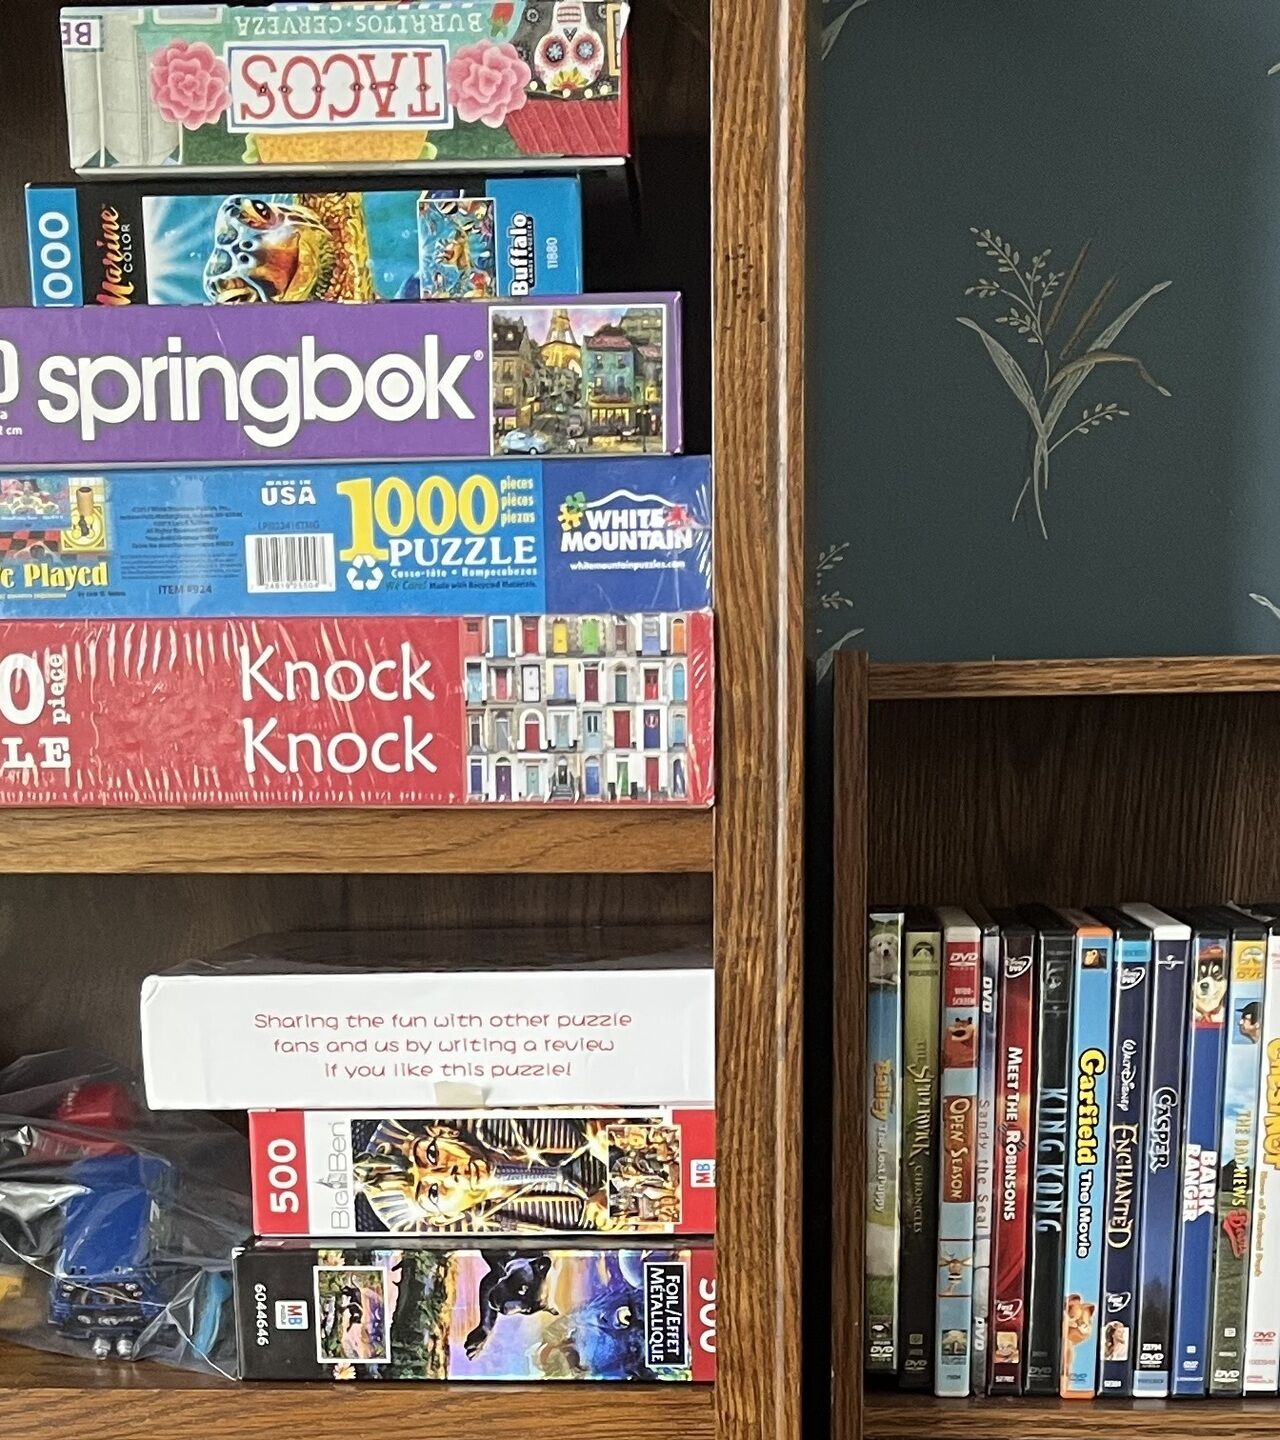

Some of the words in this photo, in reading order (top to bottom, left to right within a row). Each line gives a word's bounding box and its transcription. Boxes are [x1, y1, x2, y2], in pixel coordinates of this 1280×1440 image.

[242, 52, 443, 121] TACOS
[123, 222, 131, 277] COLOR
[509, 211, 529, 296] Buffalo
[37, 334, 473, 447] springbok
[261, 485, 316, 505] USA
[500, 476, 533, 491] pieces
[336, 475, 498, 562] 1000
[500, 511, 535, 526] piezas
[561, 530, 693, 553] MOUNTAIN
[585, 509, 665, 530] WHITE
[24, 561, 108, 587] Played
[389, 537, 536, 566] PUZZLE
[570, 560, 685, 571] whitemountainpuzzles.com
[49, 652, 69, 726] piece
[240, 642, 437, 704] Knock
[242, 714, 438, 776] Knock
[254, 1013, 338, 1030] Sharing
[347, 1014, 384, 1028] the
[392, 1014, 427, 1028] fun
[434, 1014, 482, 1028] with
[490, 1014, 549, 1027] other
[558, 1012, 632, 1030] puzzle
[274, 1038, 318, 1053] fans
[327, 1038, 366, 1052] and
[376, 1040, 398, 1052] us
[406, 1038, 432, 1054] by
[440, 1037, 516, 1054] writing
[524, 1040, 536, 1052] a
[544, 1038, 614, 1052] review
[324, 1062, 336, 1077] if
[345, 1064, 384, 1079] you
[394, 1062, 432, 1077] like
[441, 1062, 484, 1077] this
[492, 1062, 572, 1079] puzzle!
[1007, 1047, 1023, 1088] MEET
[950, 1098, 970, 1141] OPEN
[1006, 1093, 1020, 1121] THE
[1038, 1087, 1069, 1152] KING
[1076, 1048, 1107, 1164] Garfield
[1150, 1086, 1178, 1173] CASPER
[268, 1138, 299, 1214] 500
[950, 1147, 969, 1199] SEASON
[1003, 1131, 1021, 1221] ROBINSONS
[1035, 1163, 1065, 1233] KONG
[254, 1283, 269, 1346] 6044646
[648, 1267, 664, 1363] MÉTALLIQUE
[666, 1275, 680, 1356] FOIL/EFFET
